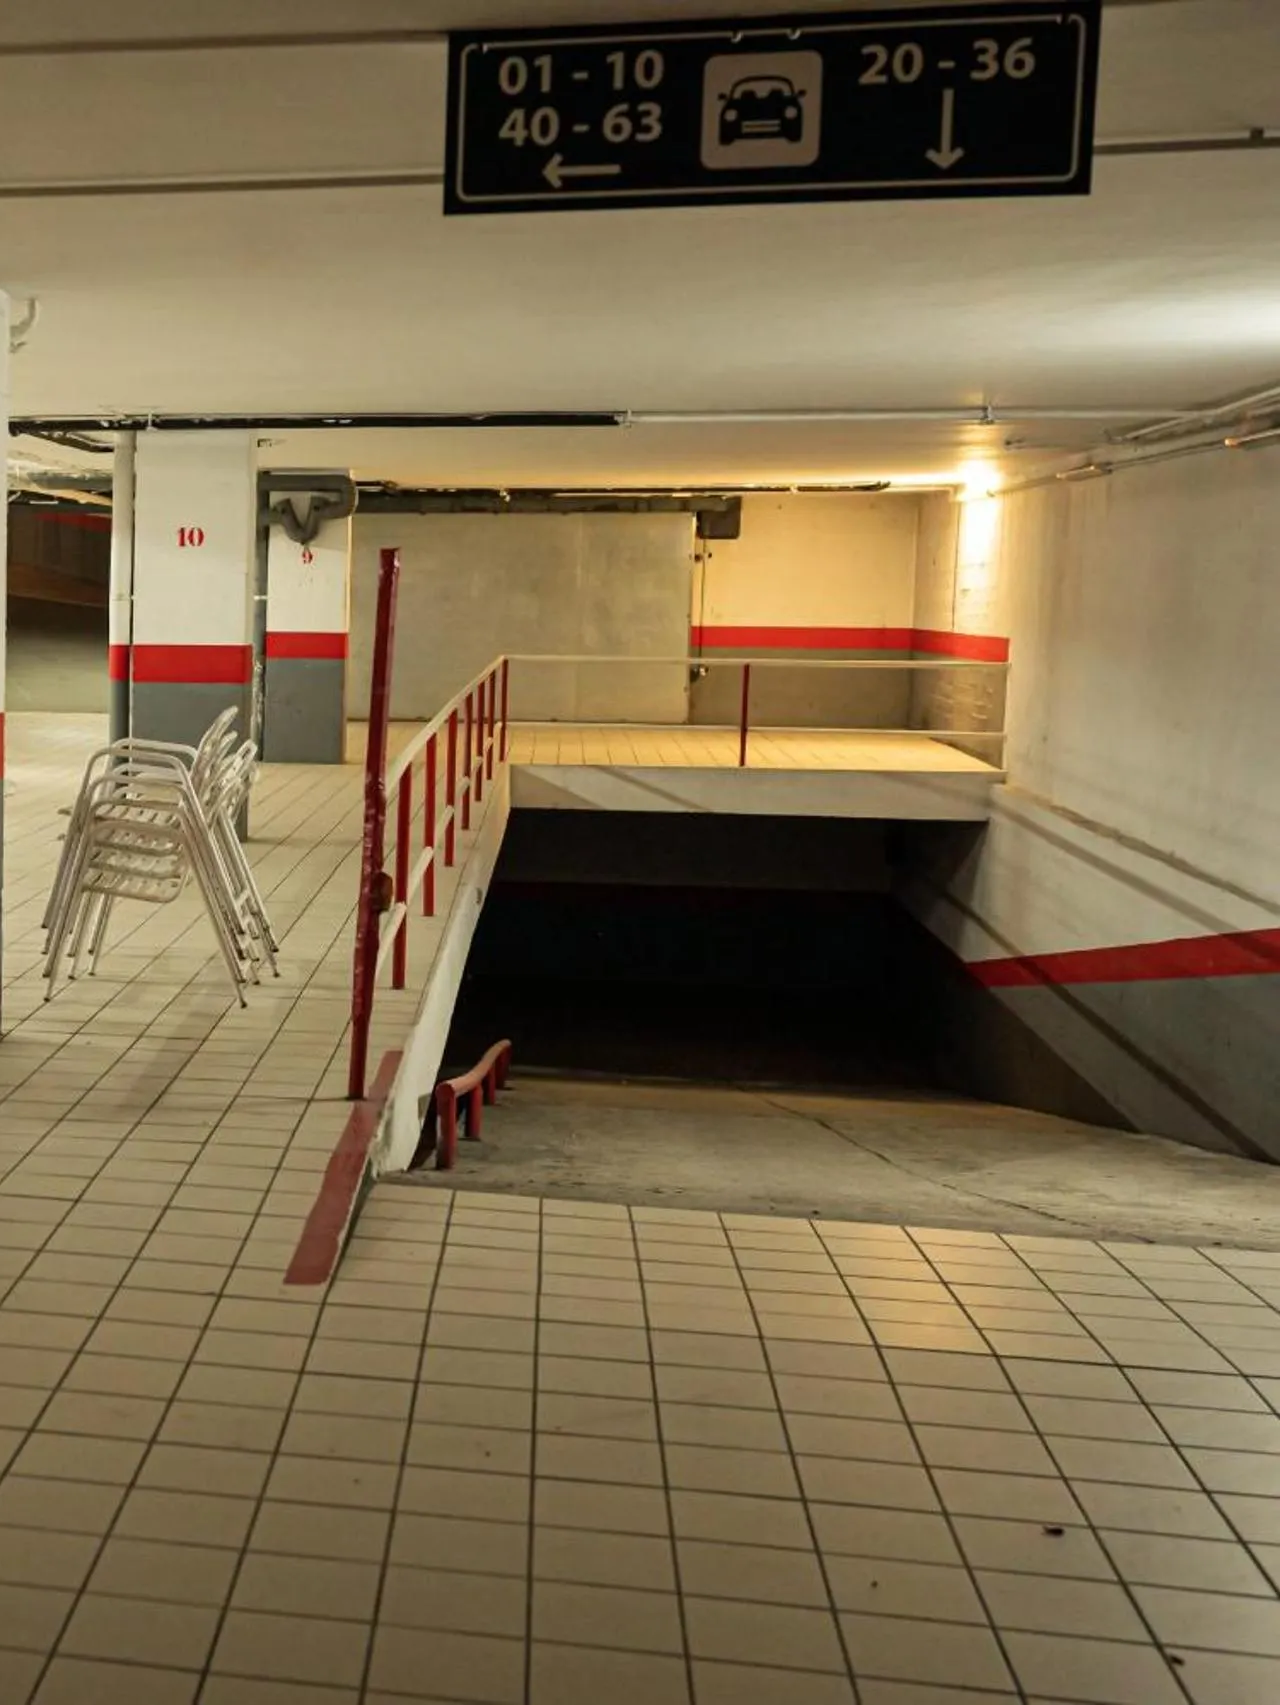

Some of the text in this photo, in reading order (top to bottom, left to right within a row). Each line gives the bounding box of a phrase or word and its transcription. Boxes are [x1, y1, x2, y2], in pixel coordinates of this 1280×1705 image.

[498, 49, 664, 95] 01 - 10
[858, 37, 1035, 84] 20 - 36
[498, 101, 663, 147] 40 - 63
[177, 527, 205, 547] 10
[302, 549, 313, 564] 9
